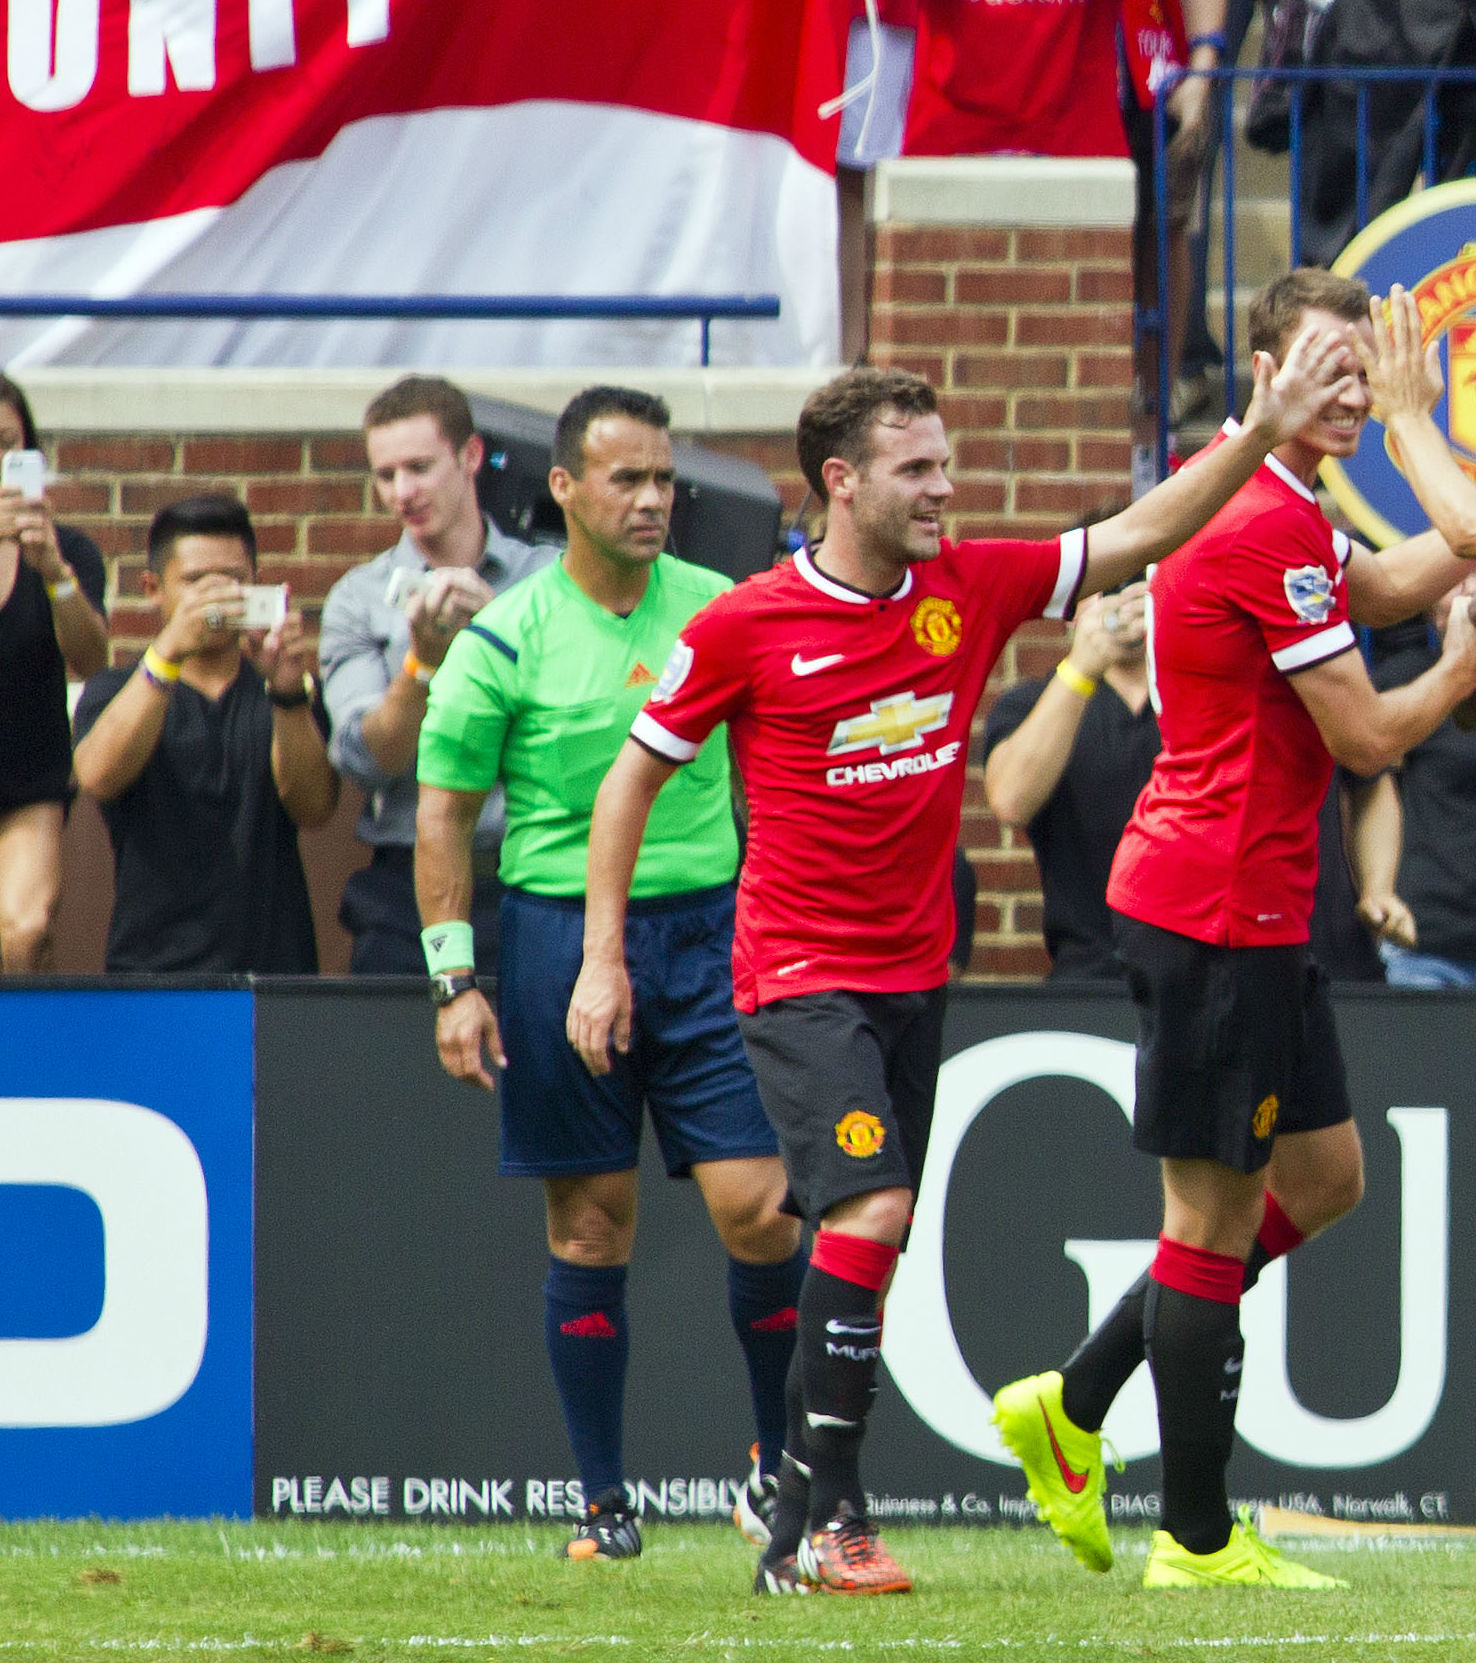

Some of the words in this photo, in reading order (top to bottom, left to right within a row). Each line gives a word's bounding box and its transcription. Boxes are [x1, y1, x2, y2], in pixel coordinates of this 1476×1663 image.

[272, 1475, 390, 1514] PLEASE
[403, 1477, 515, 1516] DRINK
[526, 1477, 750, 1517] RESNSIBLY
